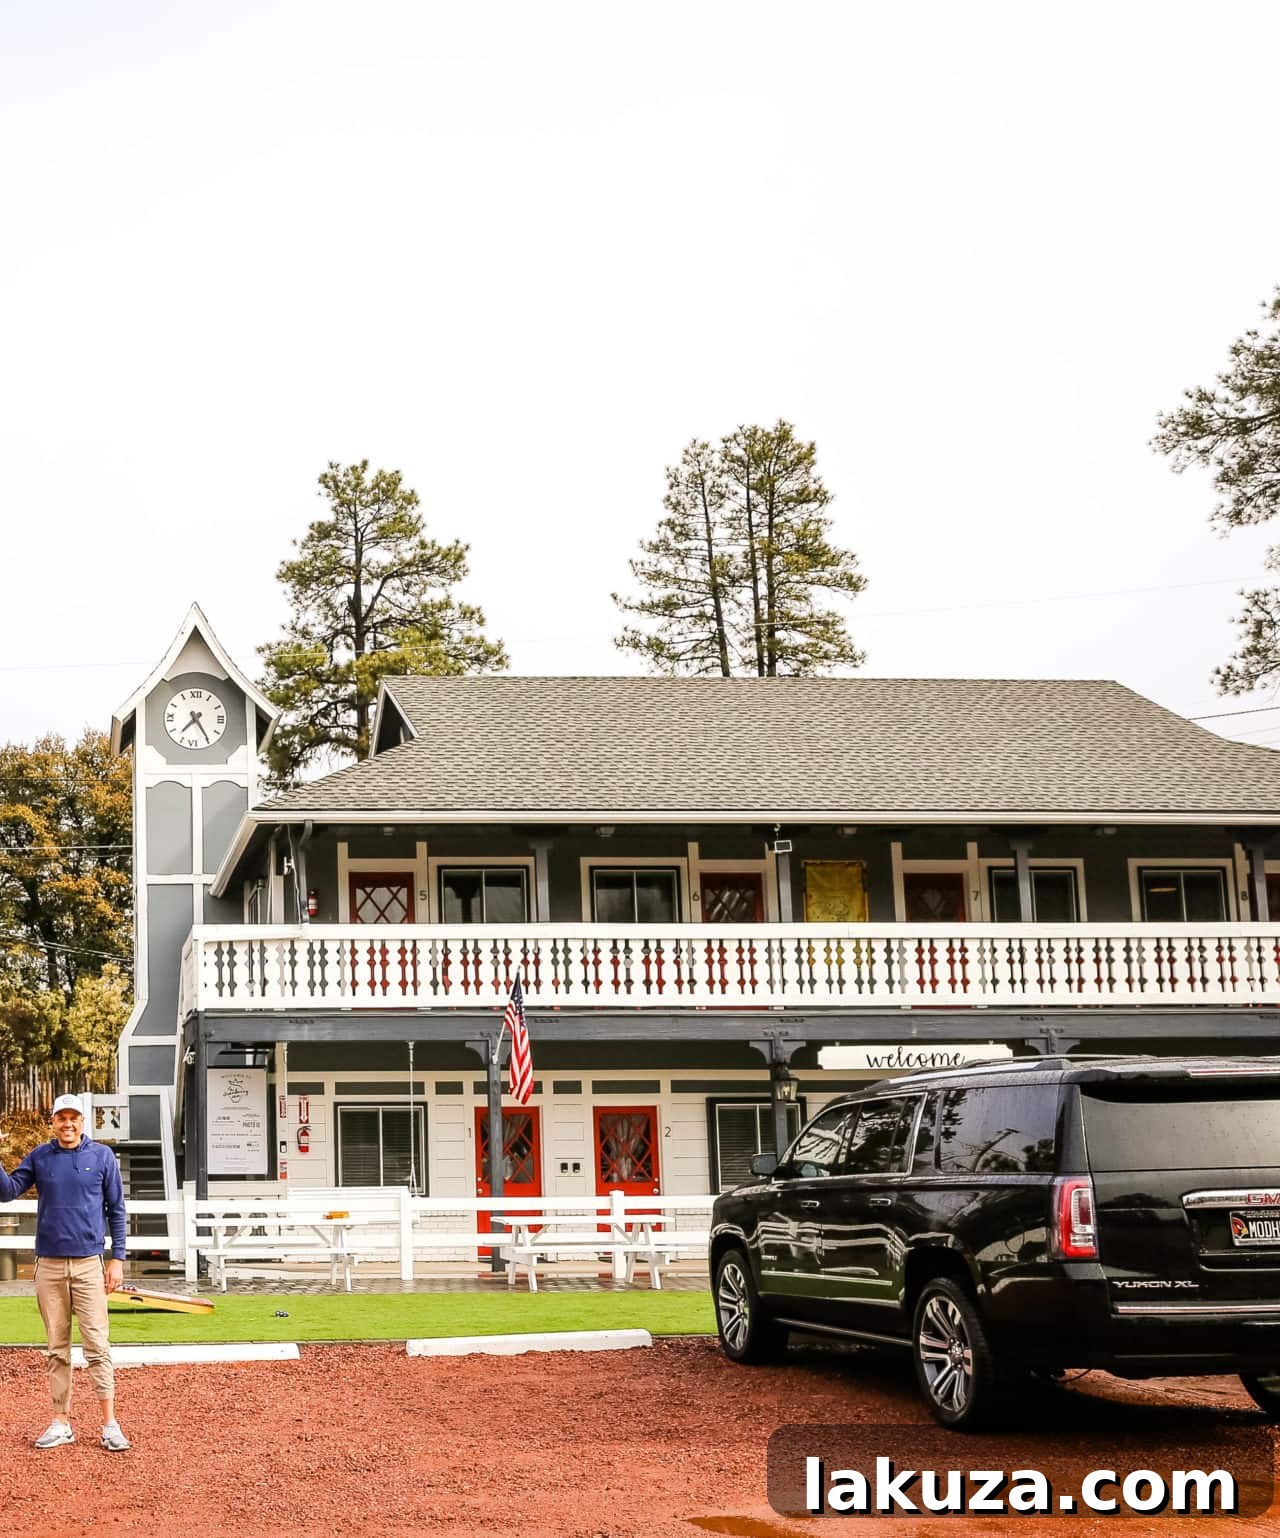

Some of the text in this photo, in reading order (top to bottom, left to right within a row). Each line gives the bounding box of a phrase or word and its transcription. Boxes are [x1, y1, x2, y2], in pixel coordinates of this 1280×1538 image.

[419, 889, 427, 901] 5
[692, 890, 700, 901] 6
[972, 890, 980, 901] 7
[1241, 890, 1249, 901] 8
[865, 1046, 965, 1068] welcome
[468, 1127, 472, 1138] 1
[664, 1126, 672, 1137] 2
[1248, 1221, 1280, 1238] MODH
